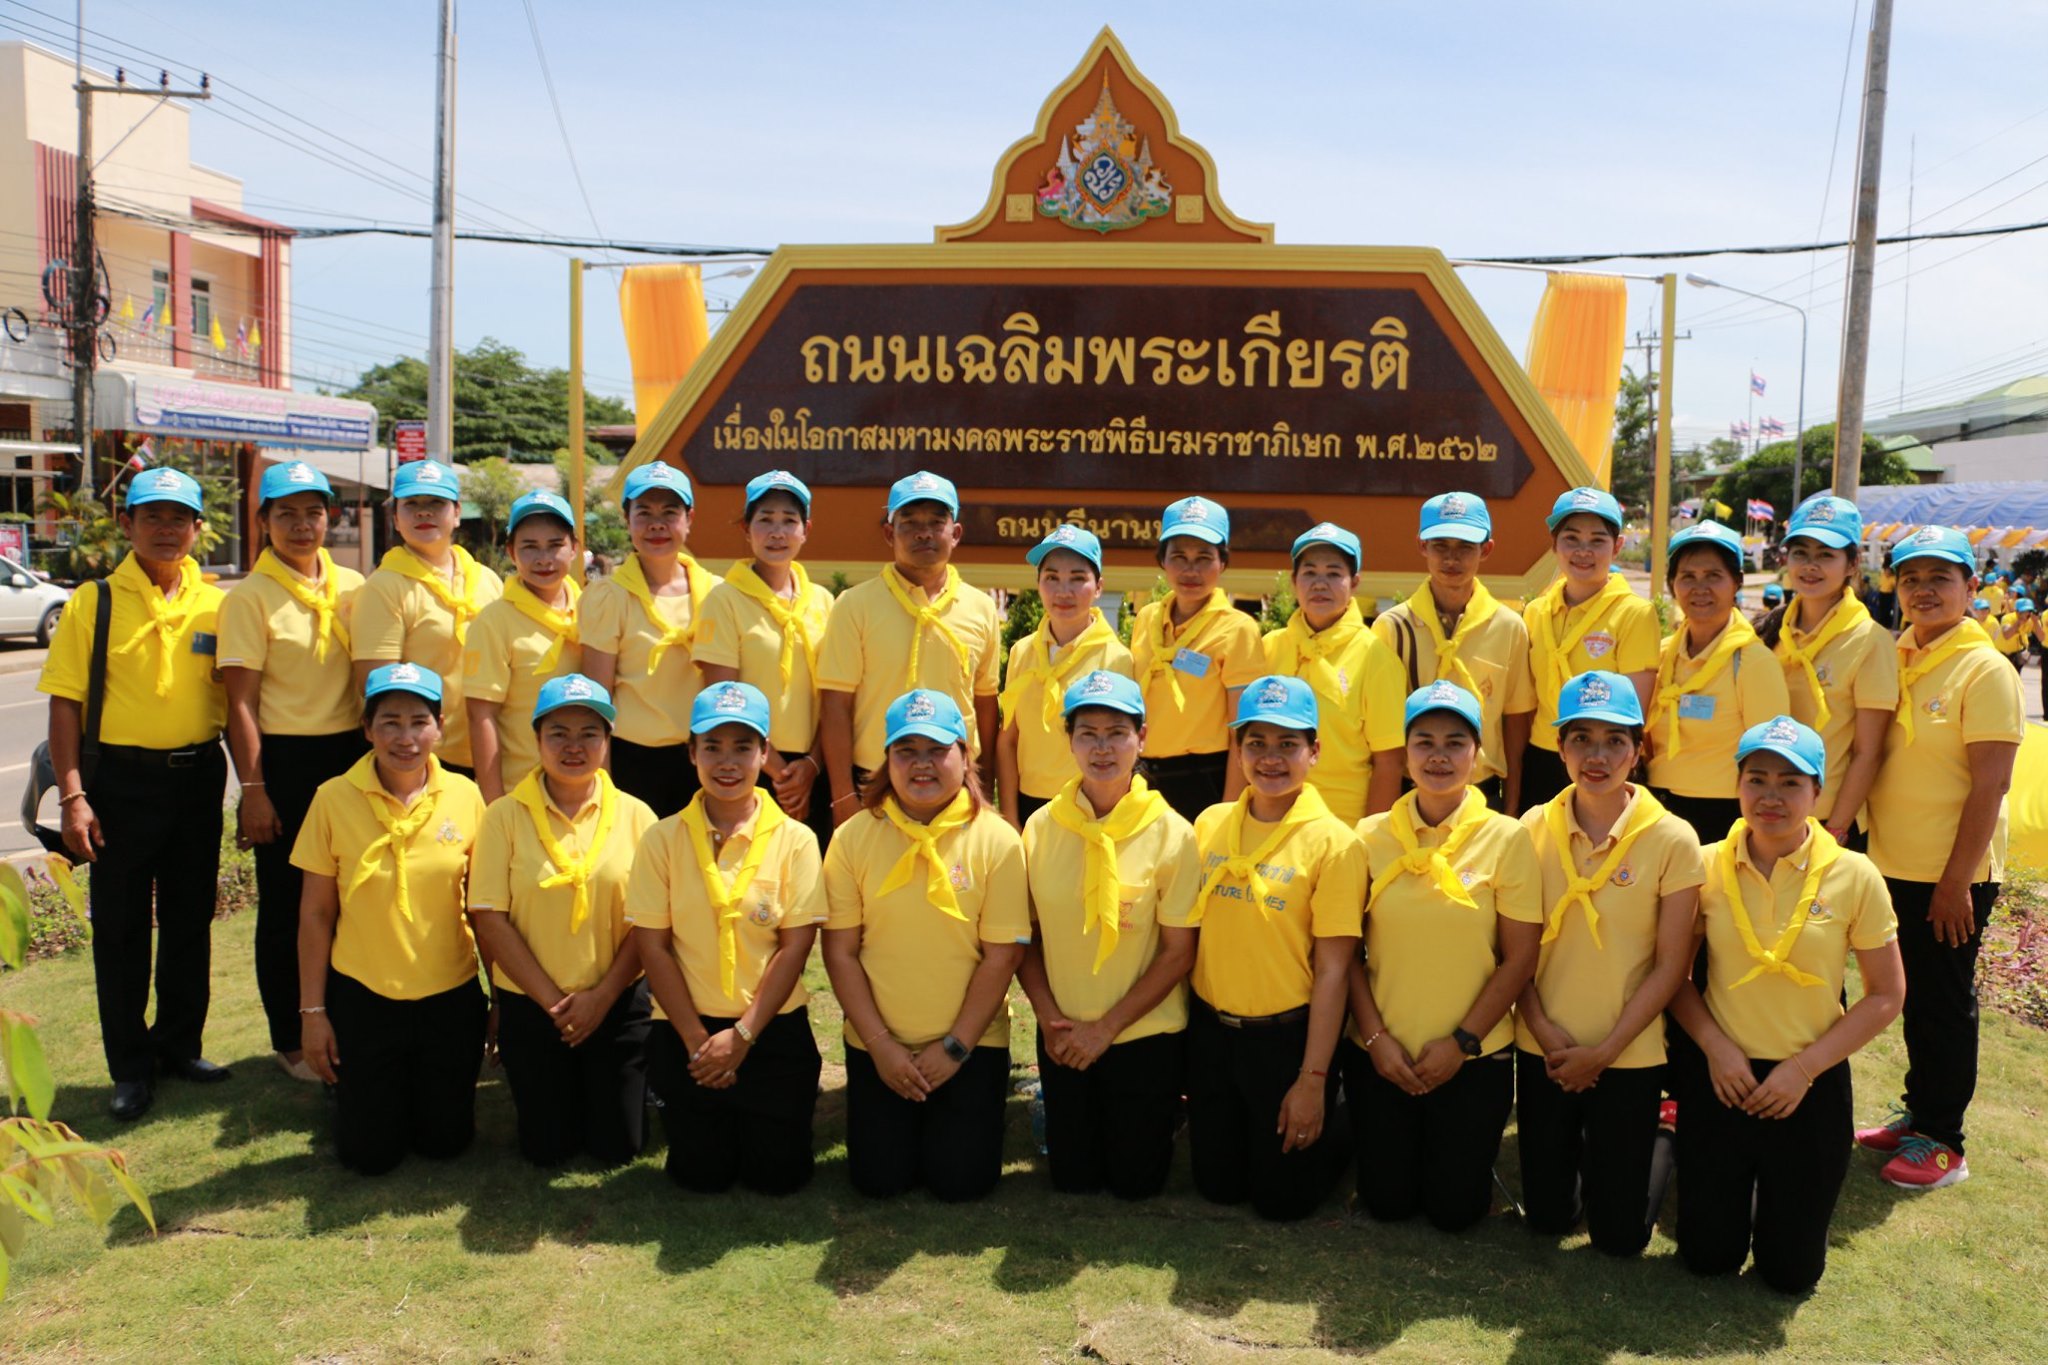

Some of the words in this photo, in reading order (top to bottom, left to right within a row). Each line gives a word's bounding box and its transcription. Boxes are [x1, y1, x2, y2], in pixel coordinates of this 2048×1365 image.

[800, 310, 1411, 390] ถนนเฉลิมพระเกียรติ
[713, 402, 1342, 458] เนื่องในโอกาสมหามงคลพระราชพิธีบรมราชาภิเษก
[1355, 432, 1498, 462] พ.ศ.๒๕๖๒
